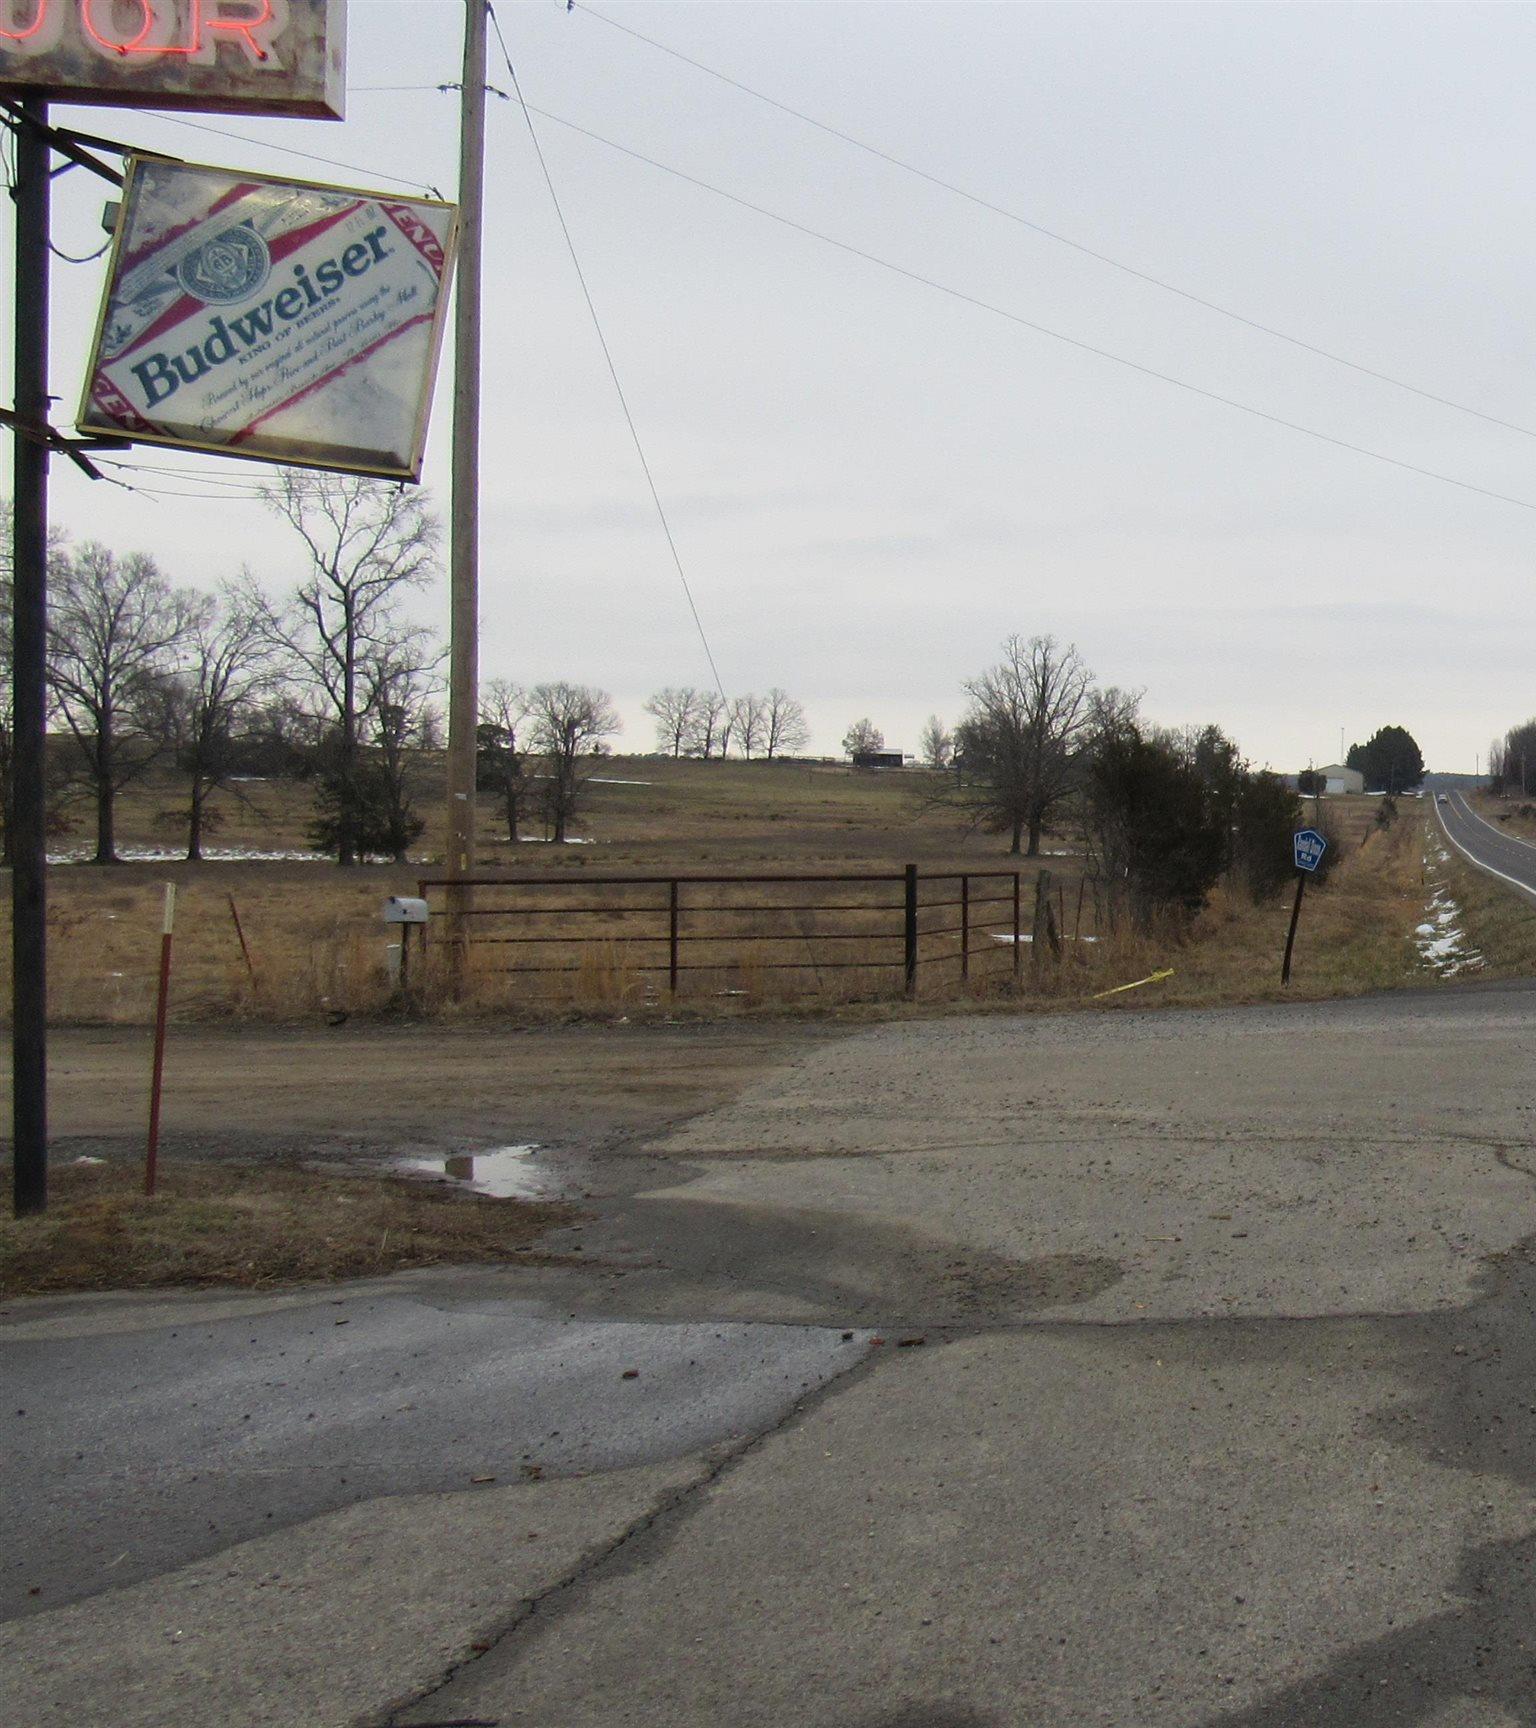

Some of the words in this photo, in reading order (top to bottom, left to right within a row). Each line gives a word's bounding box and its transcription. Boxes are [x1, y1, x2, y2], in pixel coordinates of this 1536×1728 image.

[131, 226, 388, 408] Budweiser
[238, 341, 272, 365] KING
[274, 326, 292, 341] OF
